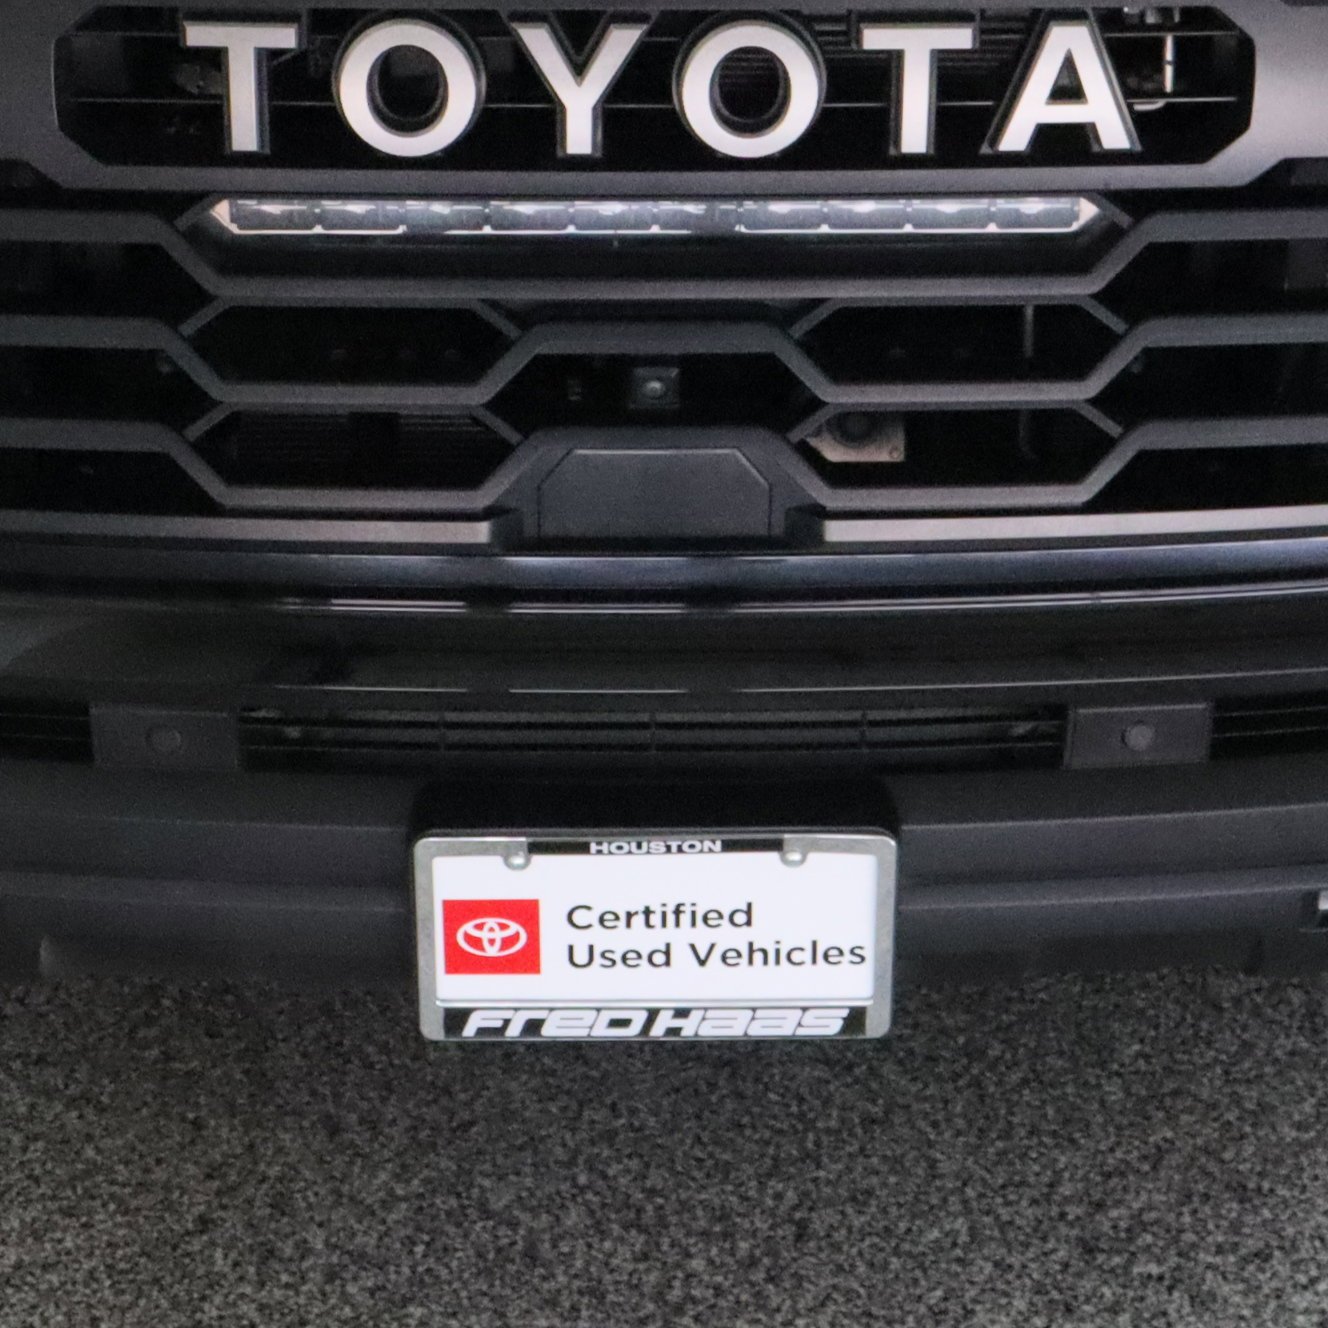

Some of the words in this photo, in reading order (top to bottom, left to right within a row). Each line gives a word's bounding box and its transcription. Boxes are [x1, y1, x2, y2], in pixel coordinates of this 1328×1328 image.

[182, 18, 1136, 158] TOYOTA
[589, 840, 723, 855] HOUSTON
[566, 902, 754, 931] Certified
[567, 942, 672, 969] Used
[688, 939, 867, 969] Vehicles
